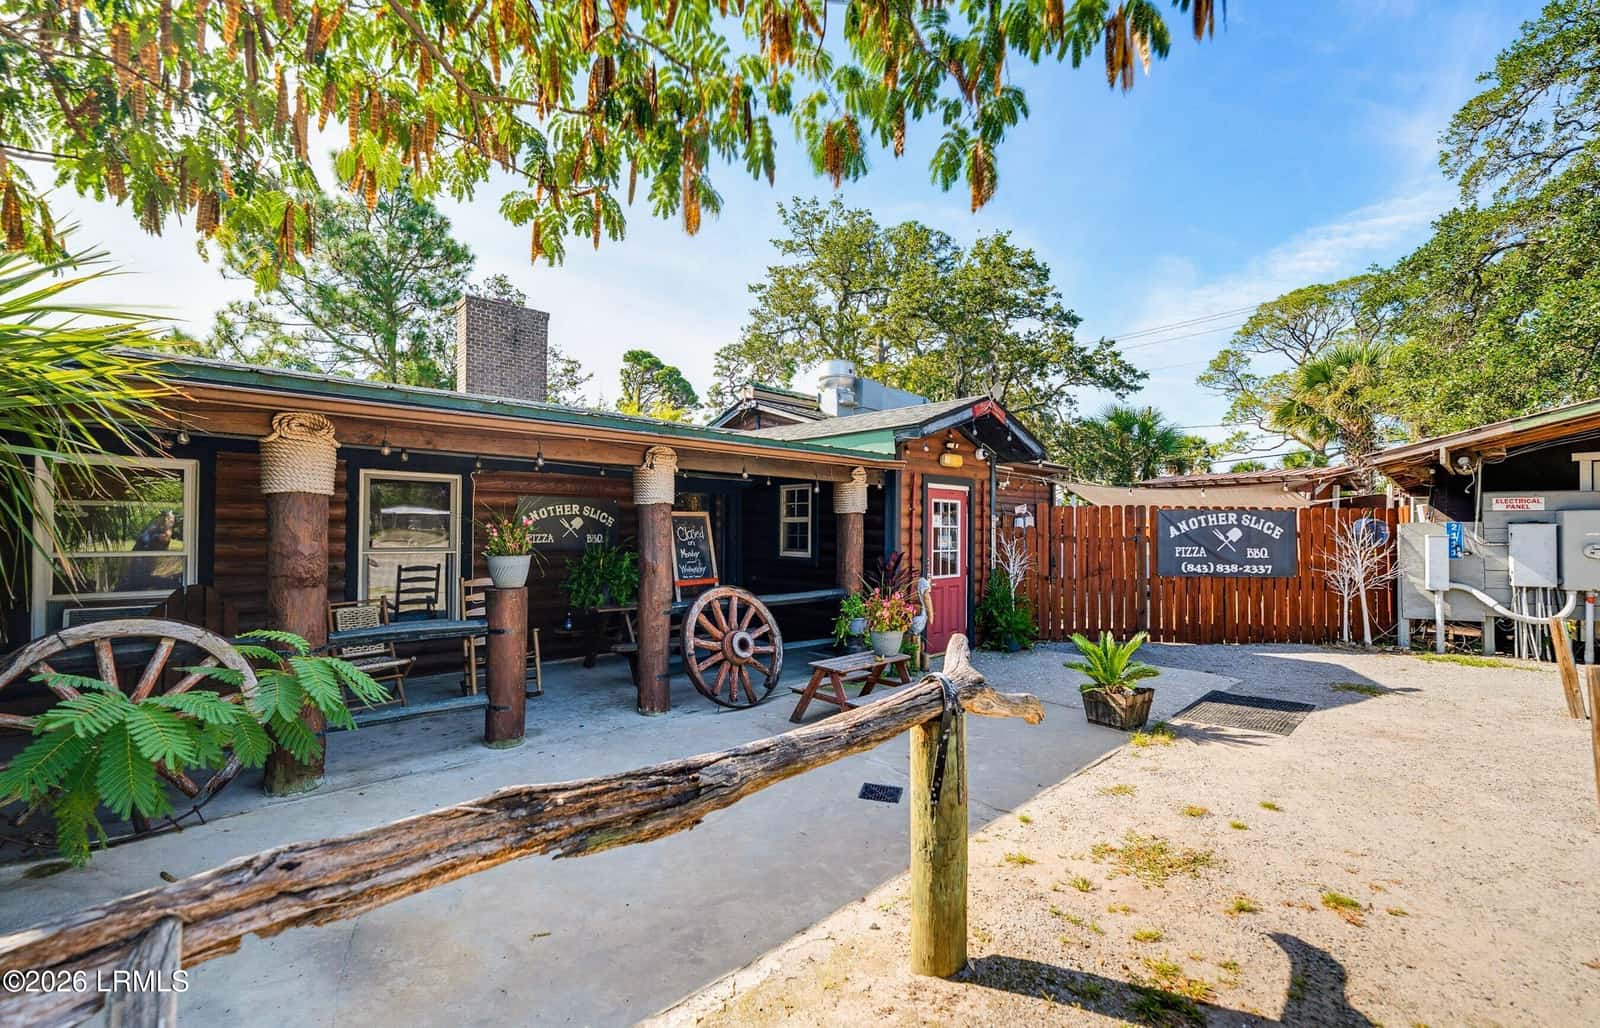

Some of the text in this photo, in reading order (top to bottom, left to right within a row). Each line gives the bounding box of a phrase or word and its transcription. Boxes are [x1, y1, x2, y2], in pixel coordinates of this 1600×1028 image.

[523, 504, 615, 527] NOTHER SLICE
[1168, 513, 1285, 540] ANOTHER SLICE
[1175, 547, 1270, 559] PIZZA BBQ
[1181, 562, 1273, 574] (843) 838-2337
